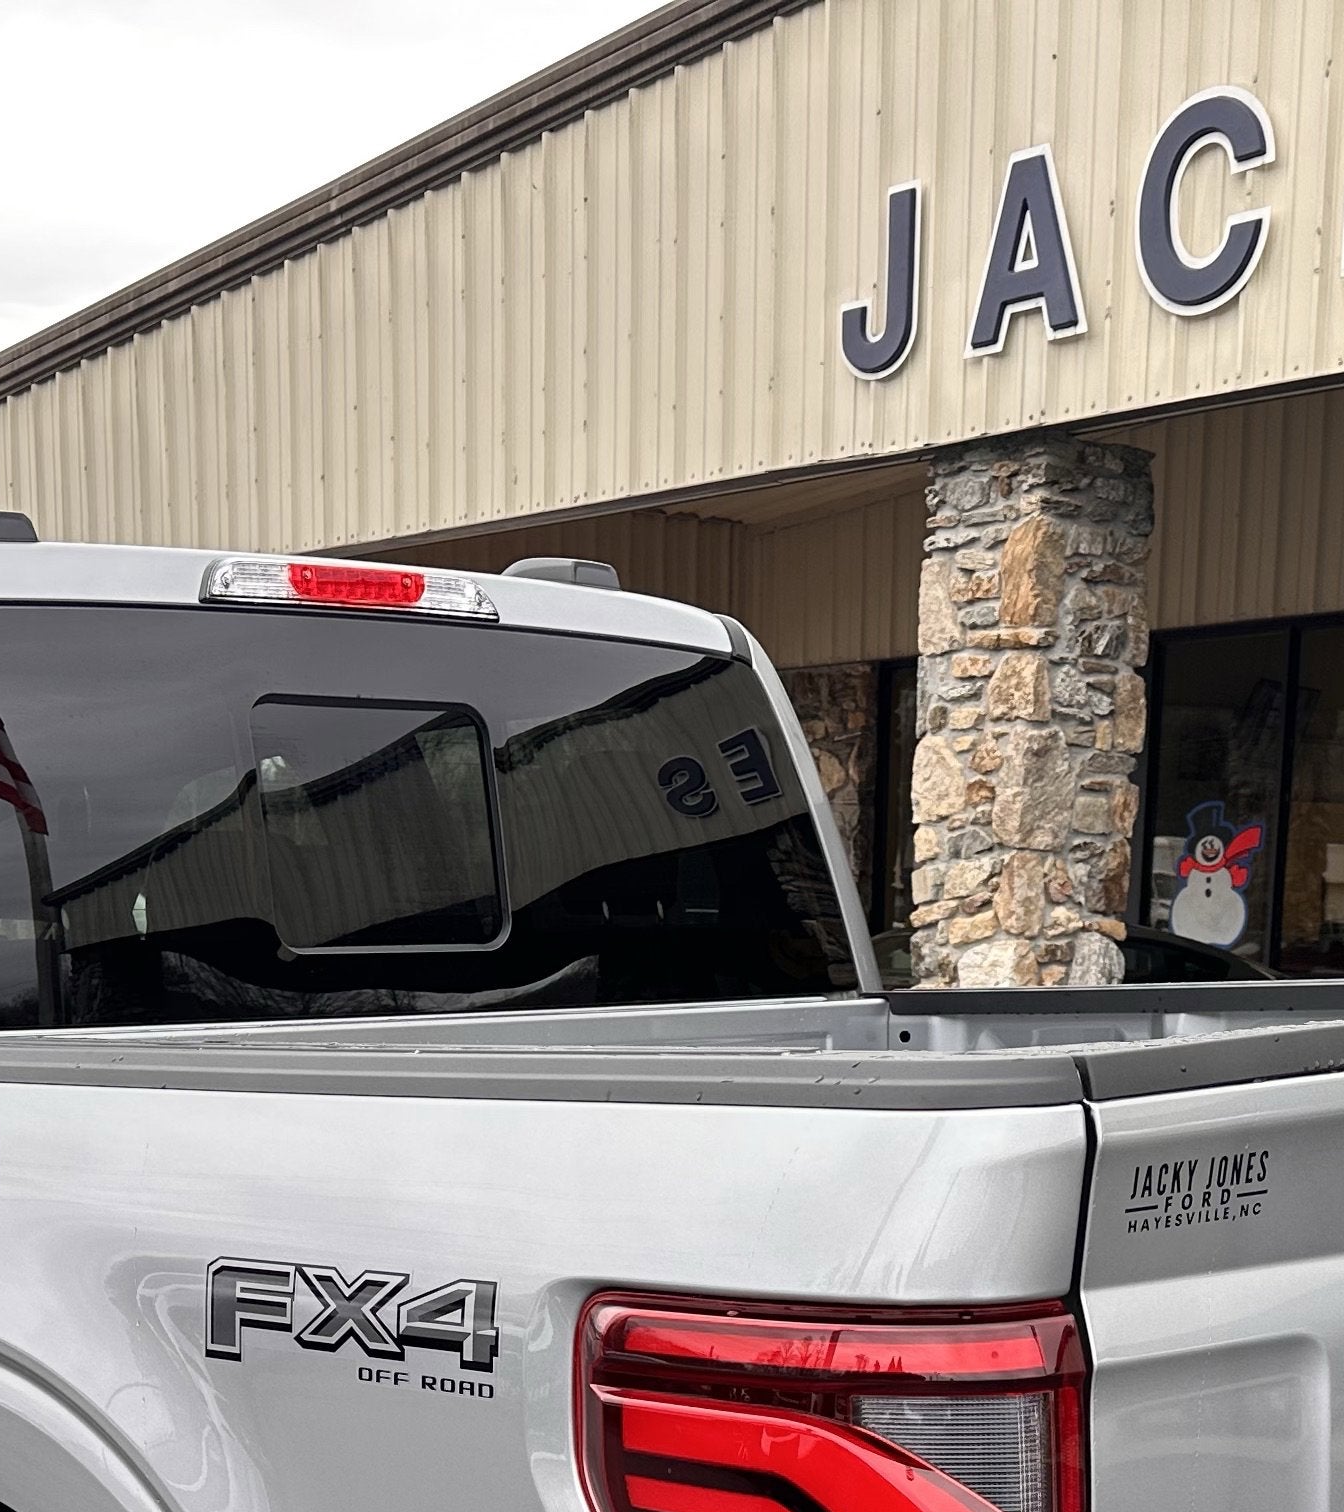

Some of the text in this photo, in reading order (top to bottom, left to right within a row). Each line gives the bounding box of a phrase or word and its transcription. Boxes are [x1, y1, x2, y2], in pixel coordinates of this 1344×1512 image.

[1130, 1150, 1269, 1200] JACKY JONES
[1164, 1188, 1231, 1213] FORD
[205, 1256, 500, 1374] FX4
[358, 1366, 495, 1400] OFF ROAD
